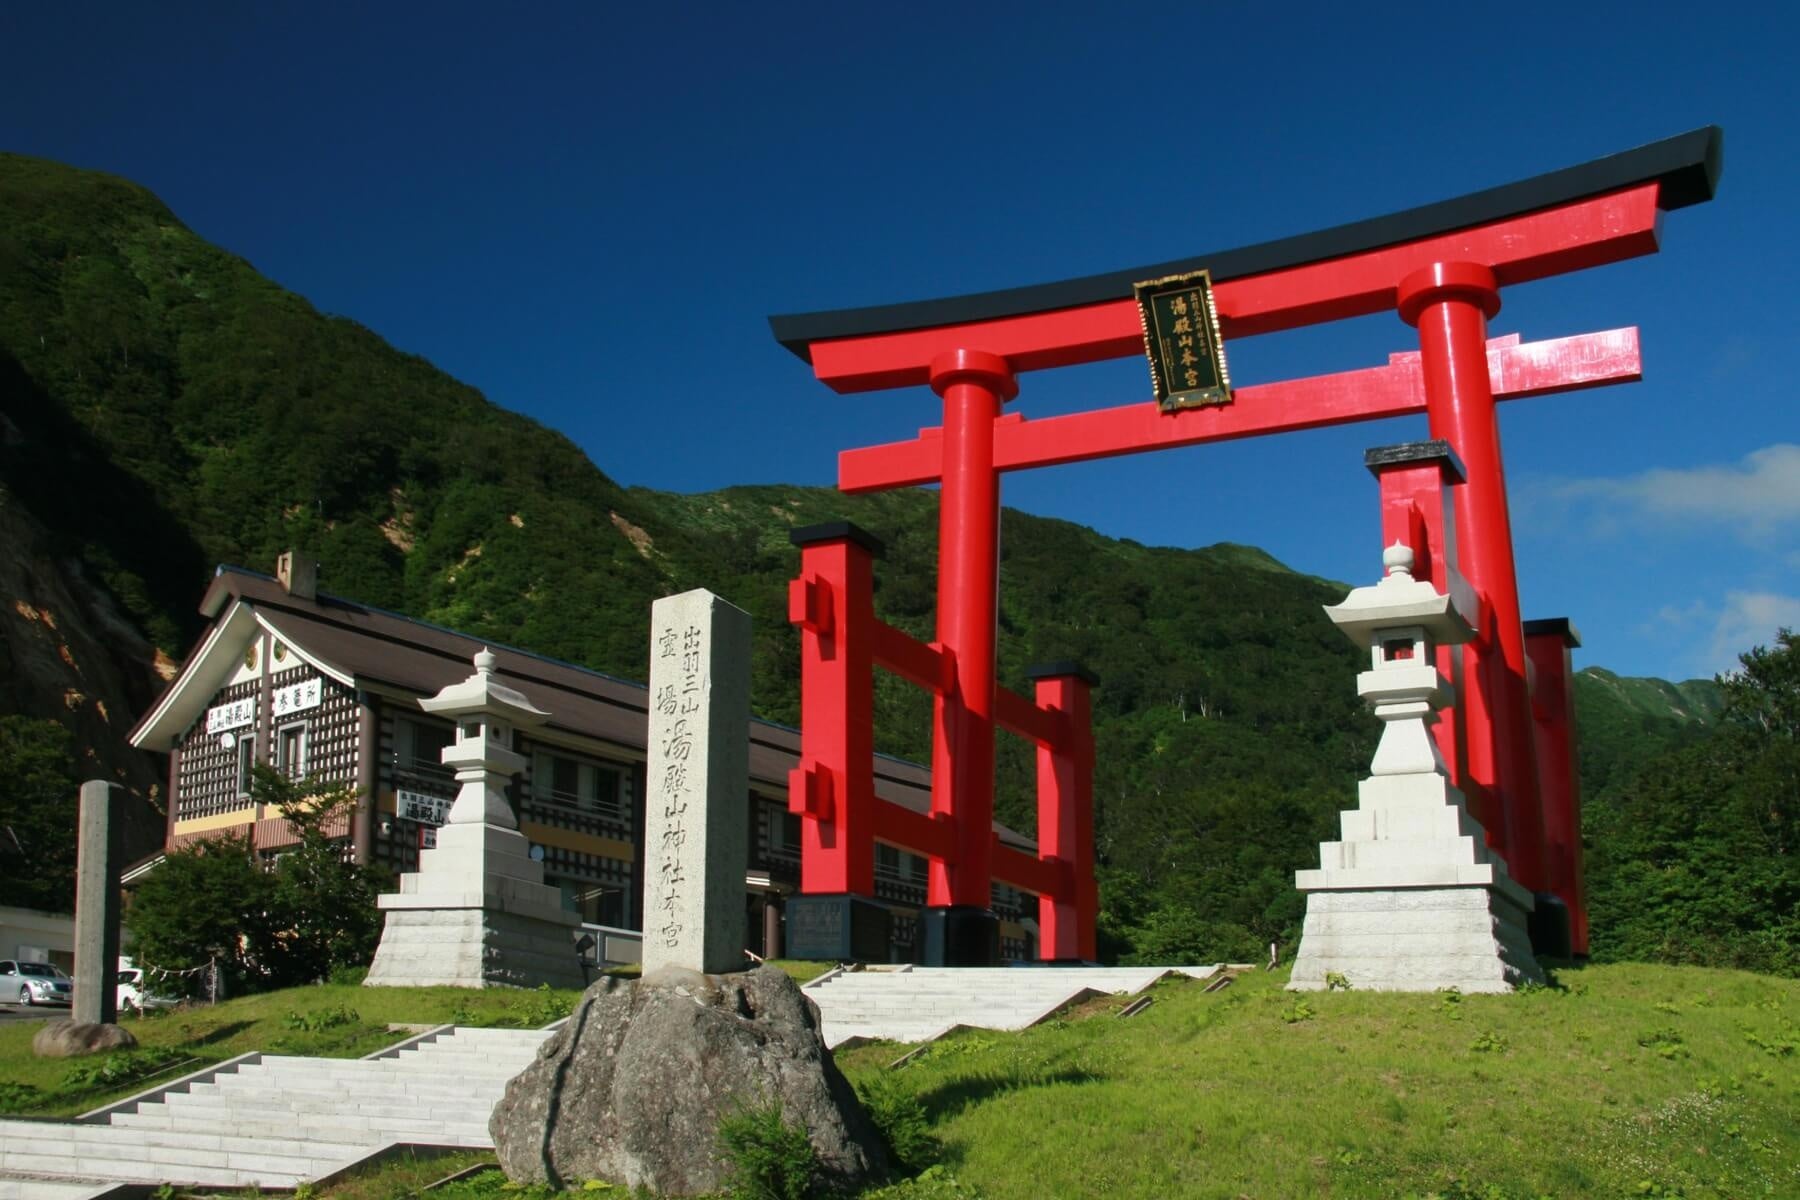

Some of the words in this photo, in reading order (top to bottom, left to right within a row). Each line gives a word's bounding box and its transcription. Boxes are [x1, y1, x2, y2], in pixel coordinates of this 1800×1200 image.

[1170, 296, 1198, 386] 湯殿山本宮
[681, 626, 701, 715] 出羽三山
[661, 719, 693, 948] 湯殿山神社本宮
